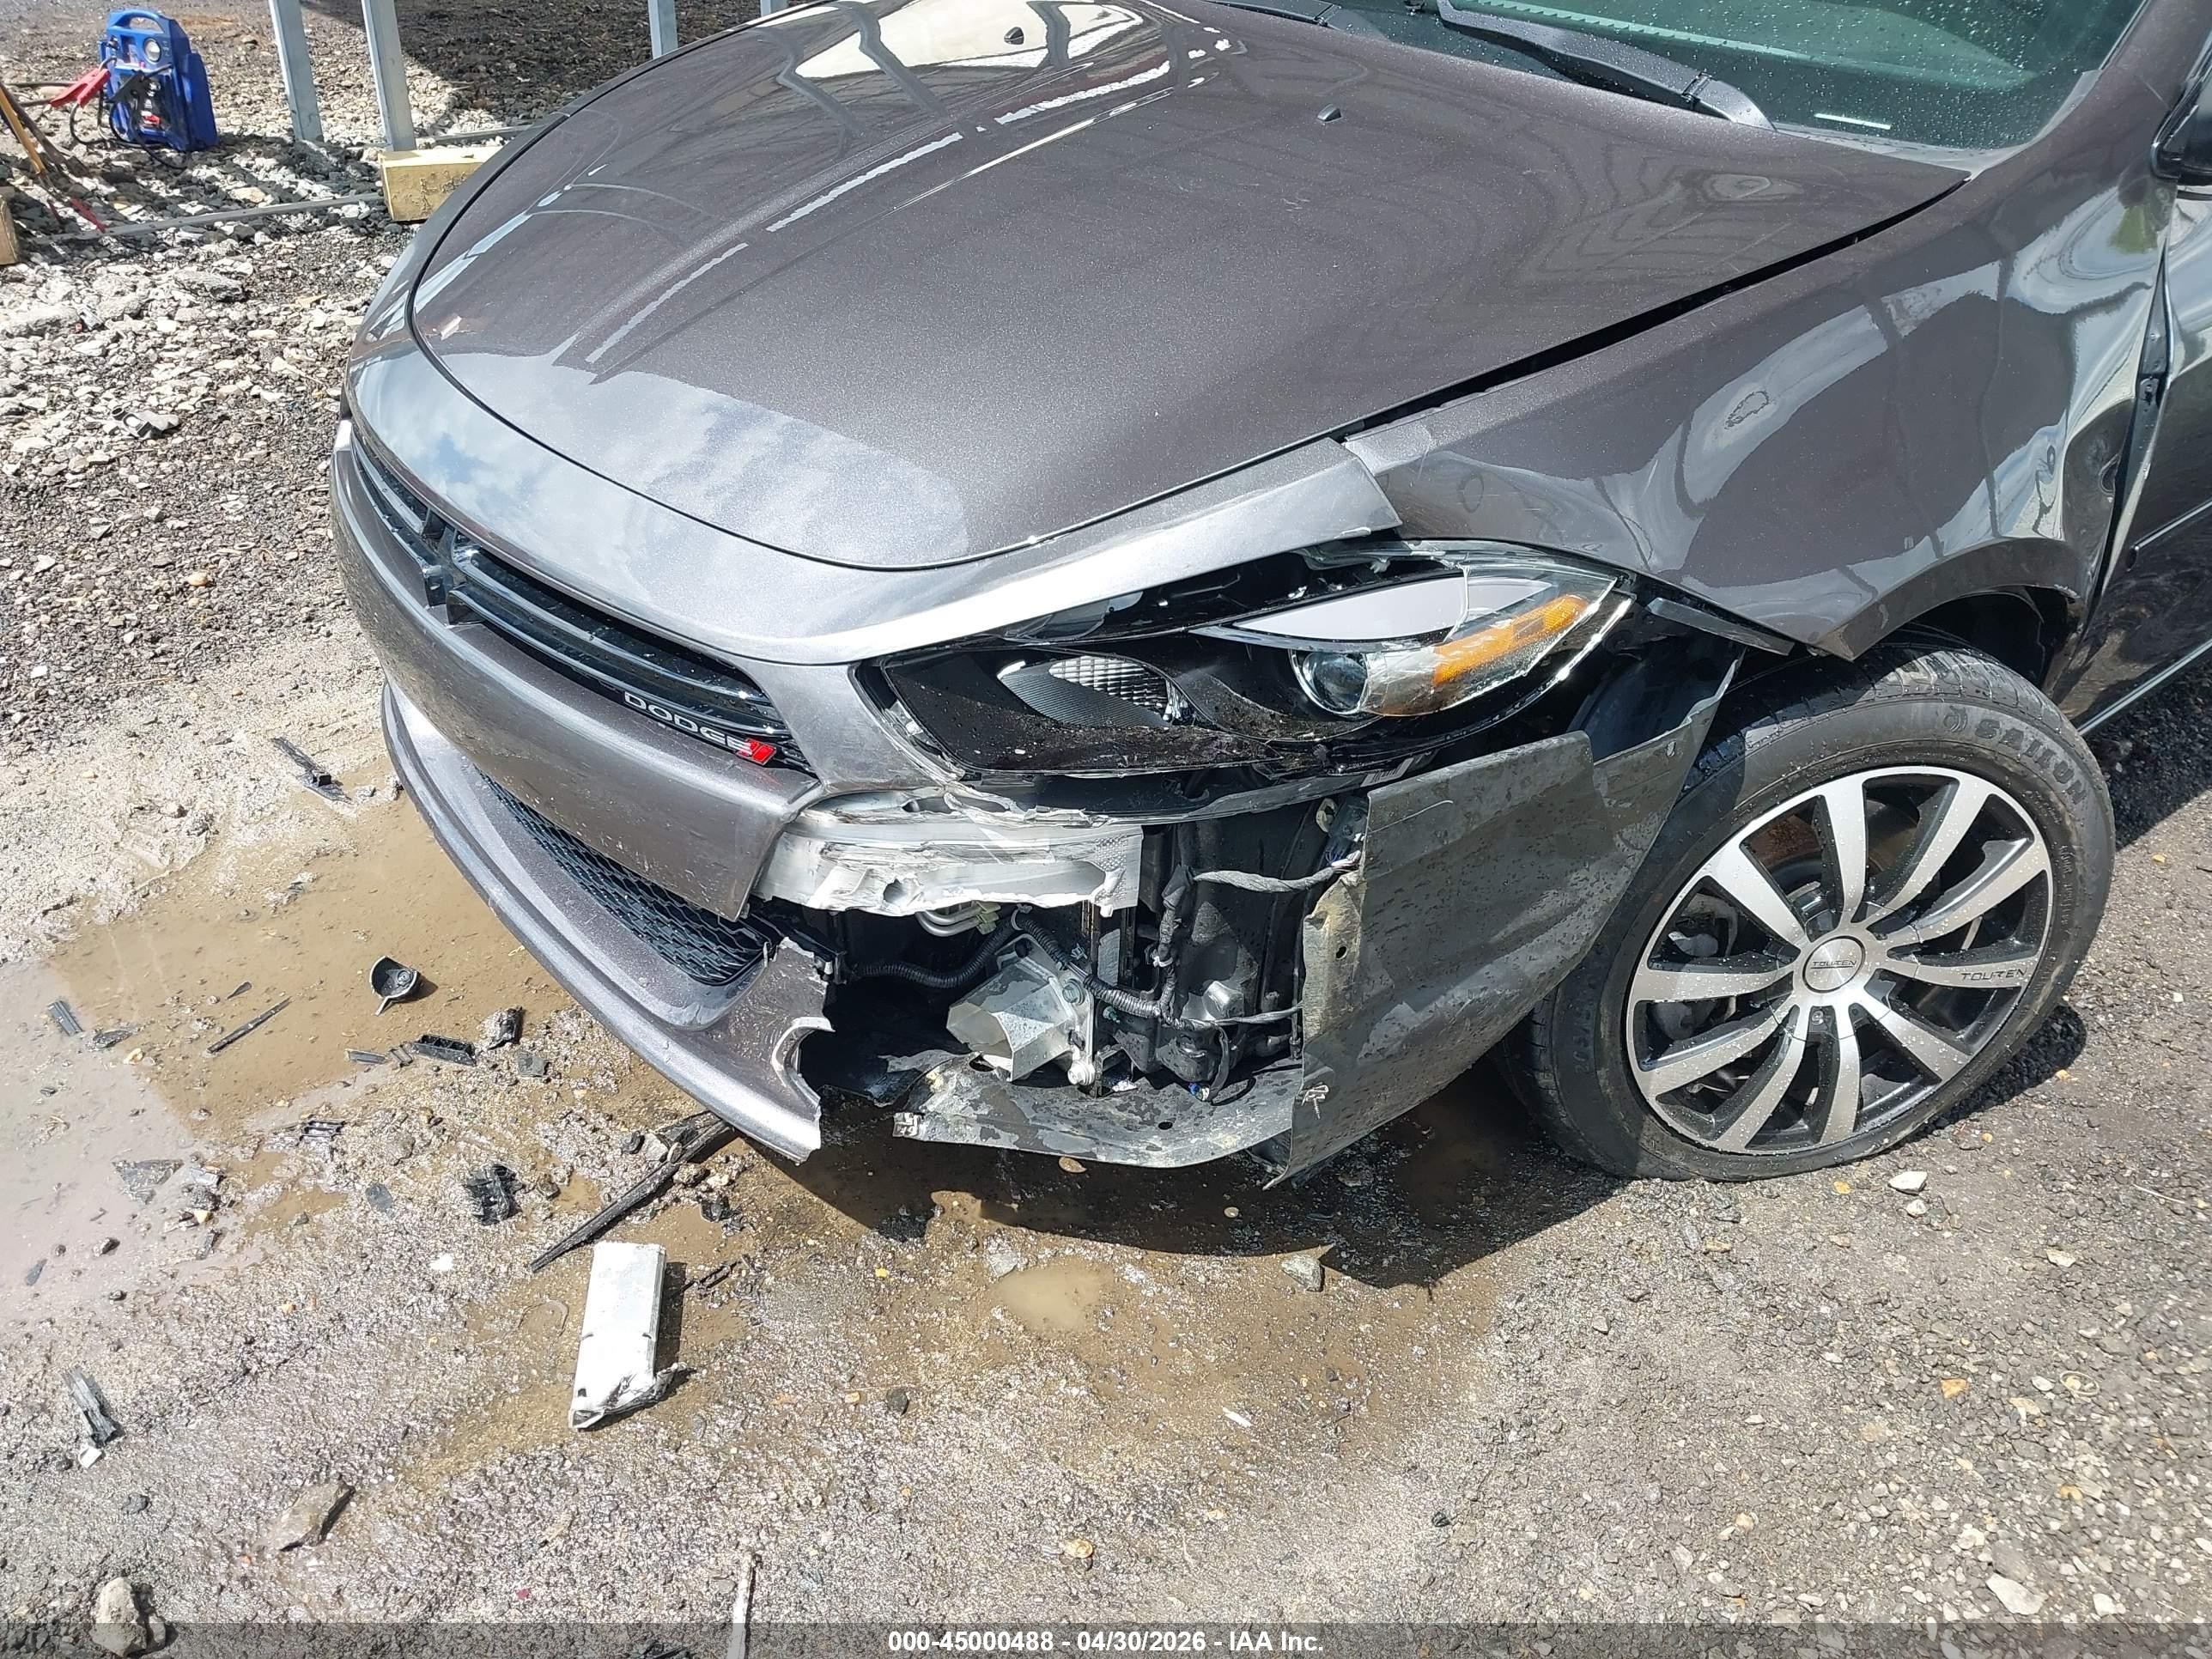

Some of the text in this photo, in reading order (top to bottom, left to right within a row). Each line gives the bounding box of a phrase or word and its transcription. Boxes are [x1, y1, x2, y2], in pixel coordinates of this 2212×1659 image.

[624, 691, 752, 756] DODGE
[1975, 719, 2088, 805] SAILUN
[1960, 967, 2027, 981] TOUREN
